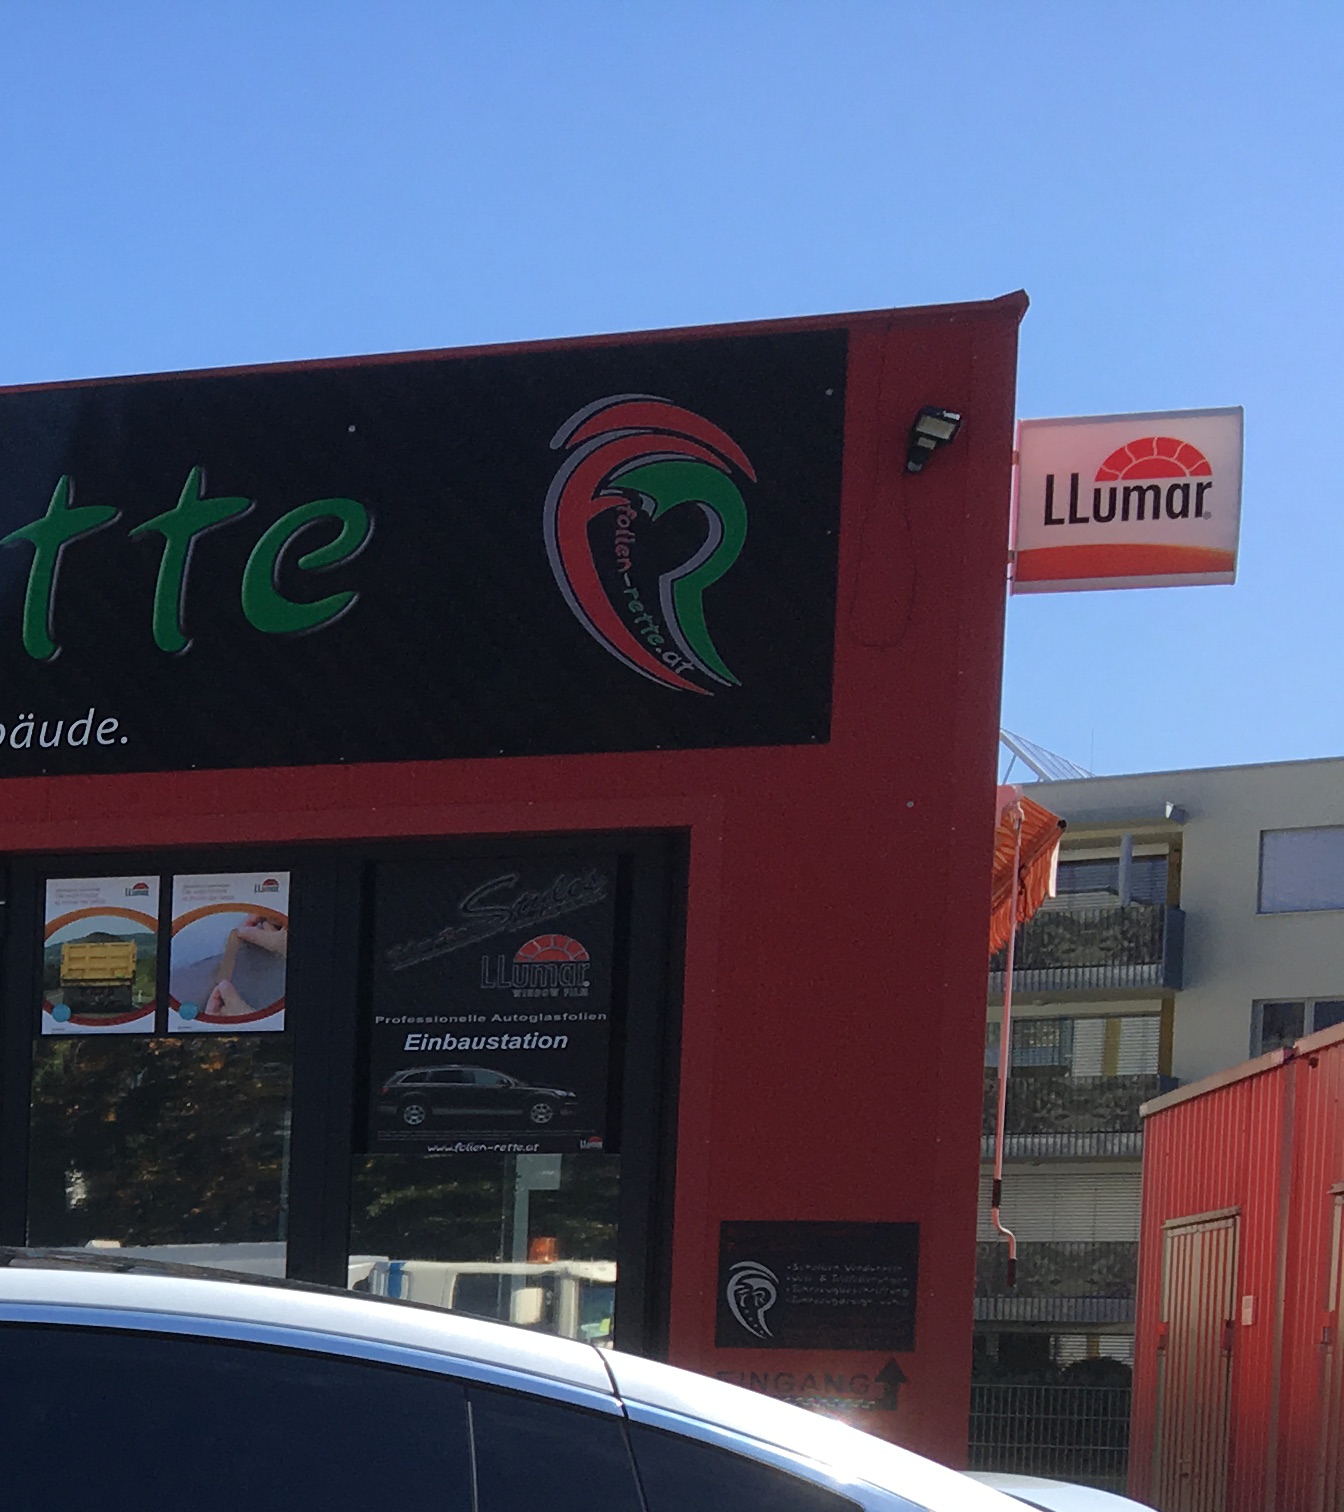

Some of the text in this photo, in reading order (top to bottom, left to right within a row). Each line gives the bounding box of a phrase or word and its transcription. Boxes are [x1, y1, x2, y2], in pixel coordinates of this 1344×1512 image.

[1043, 472, 1213, 525] LLumar
[375, 1012, 608, 1025] Professionelle Autoglasfolien
[403, 1031, 569, 1051] Einbaustation
